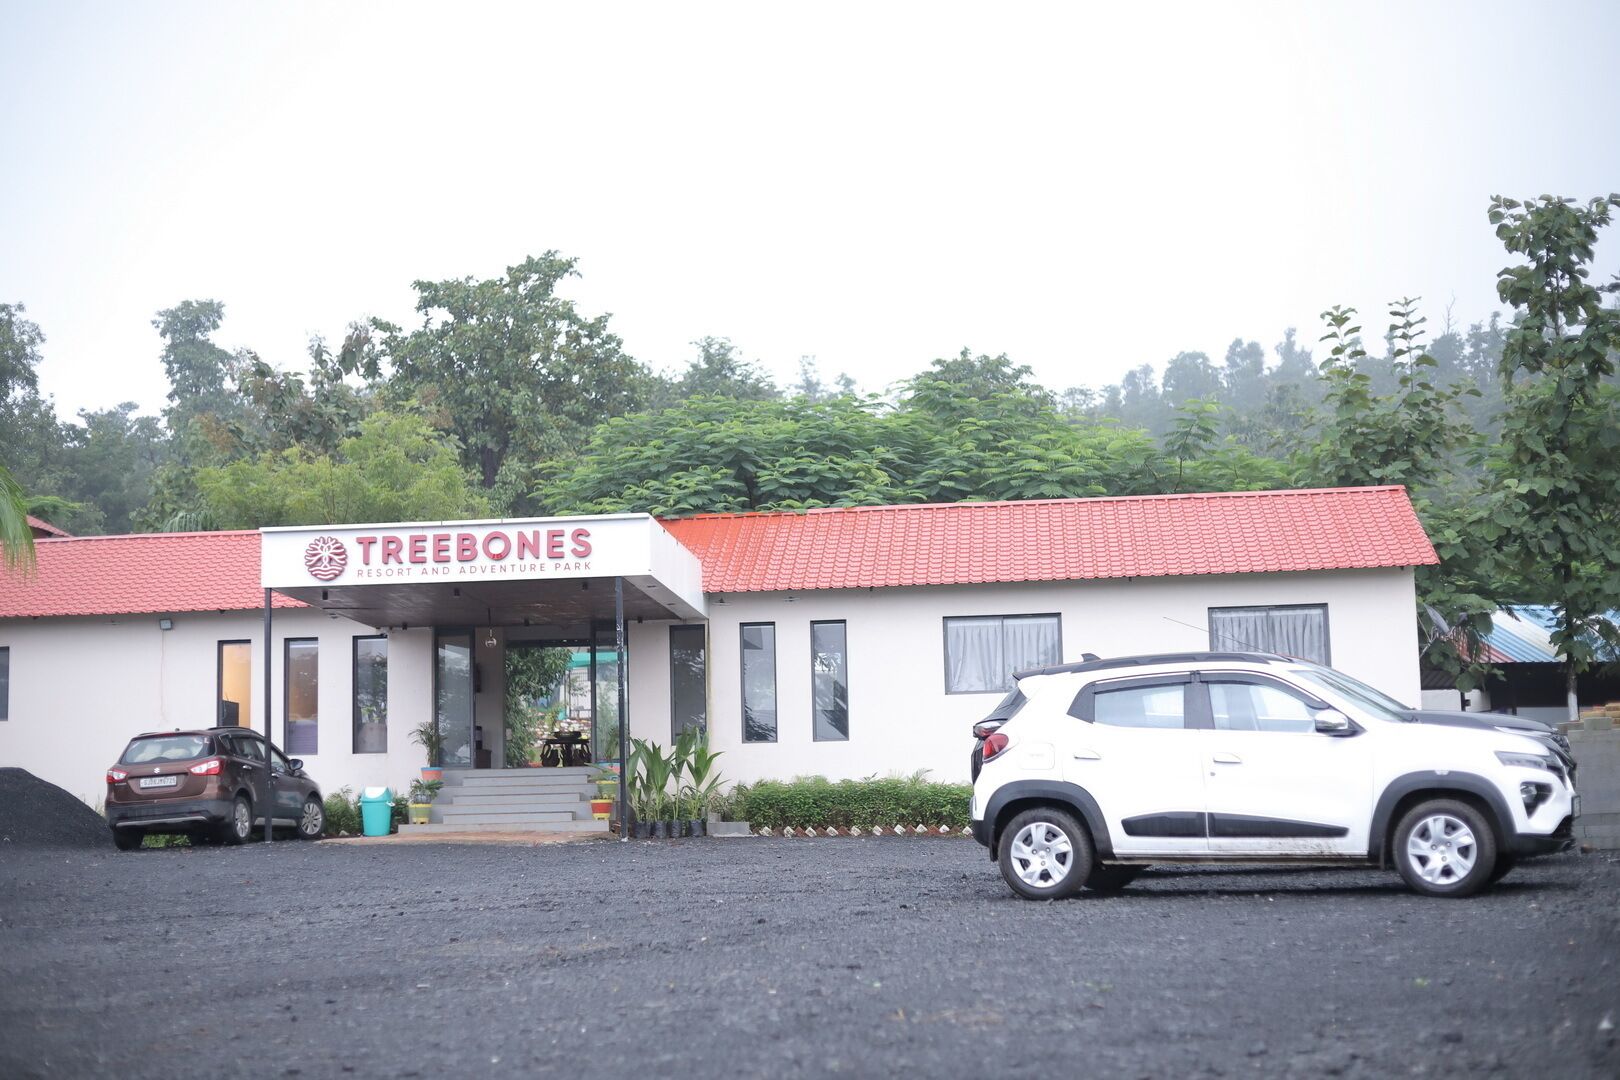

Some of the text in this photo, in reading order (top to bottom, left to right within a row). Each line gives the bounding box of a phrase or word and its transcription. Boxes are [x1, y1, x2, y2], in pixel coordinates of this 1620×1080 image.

[356, 528, 592, 565] TREEBONES
[357, 561, 591, 578] RESORT AND ADVENTURE PARK
